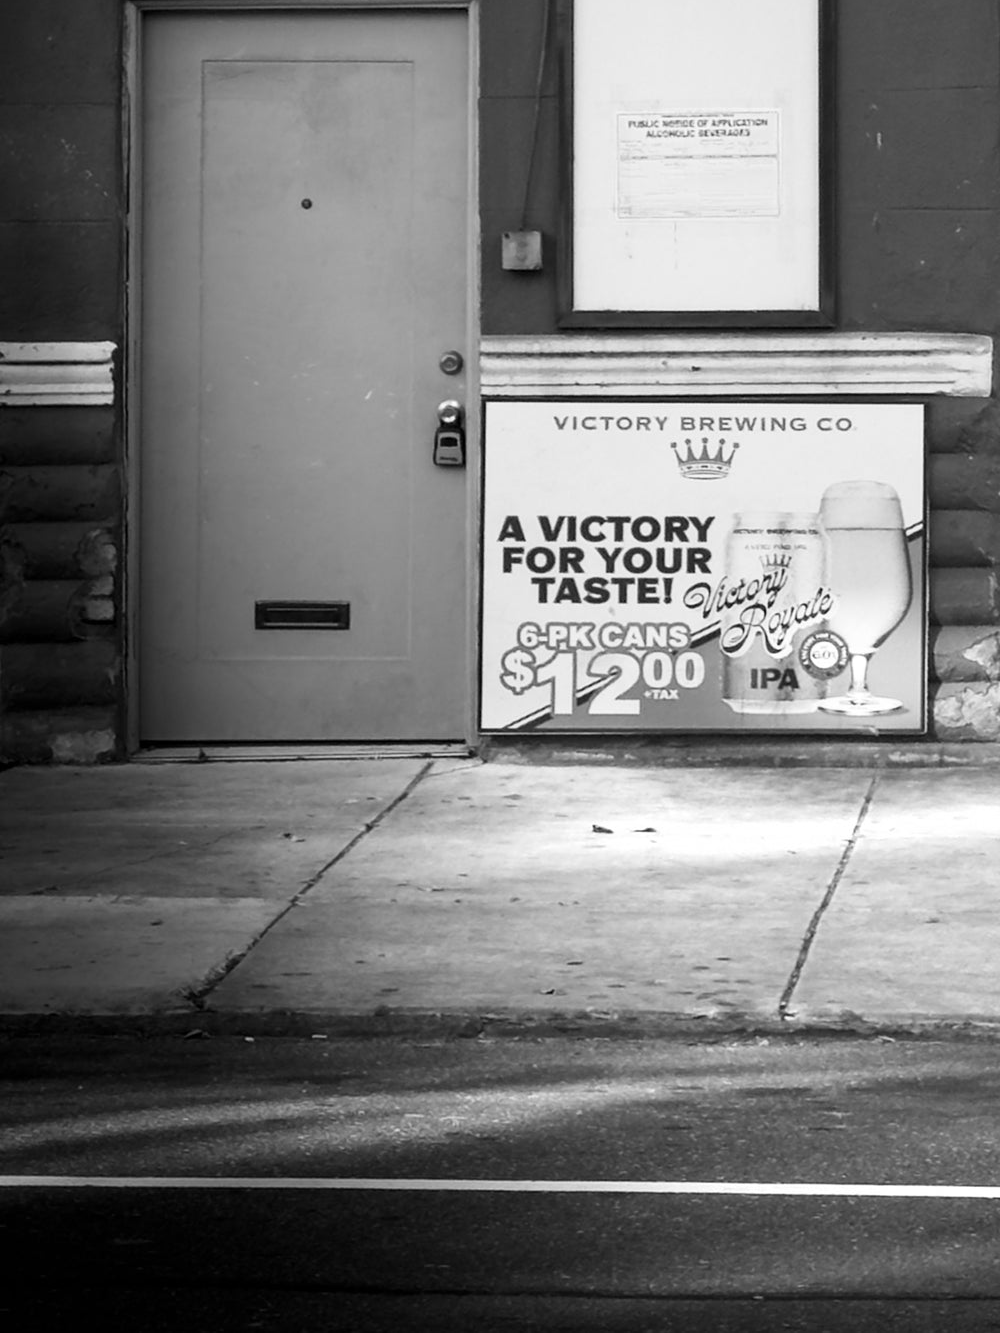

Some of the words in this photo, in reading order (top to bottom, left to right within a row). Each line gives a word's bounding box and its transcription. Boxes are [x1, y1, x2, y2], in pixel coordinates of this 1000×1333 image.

[697, 119, 709, 128] OF
[711, 119, 768, 128] APPLICATION
[553, 416, 669, 431] VICTORY
[680, 416, 807, 432] BREWING
[497, 515, 526, 542] A
[537, 515, 716, 542] VICTORY
[501, 547, 586, 574] FOR
[598, 547, 713, 574] YOUR
[530, 578, 673, 604] TASTE!
[683, 569, 789, 619] Victory
[518, 623, 595, 649] 6-PK
[600, 623, 691, 649] CANS
[750, 668, 800, 690] IPA
